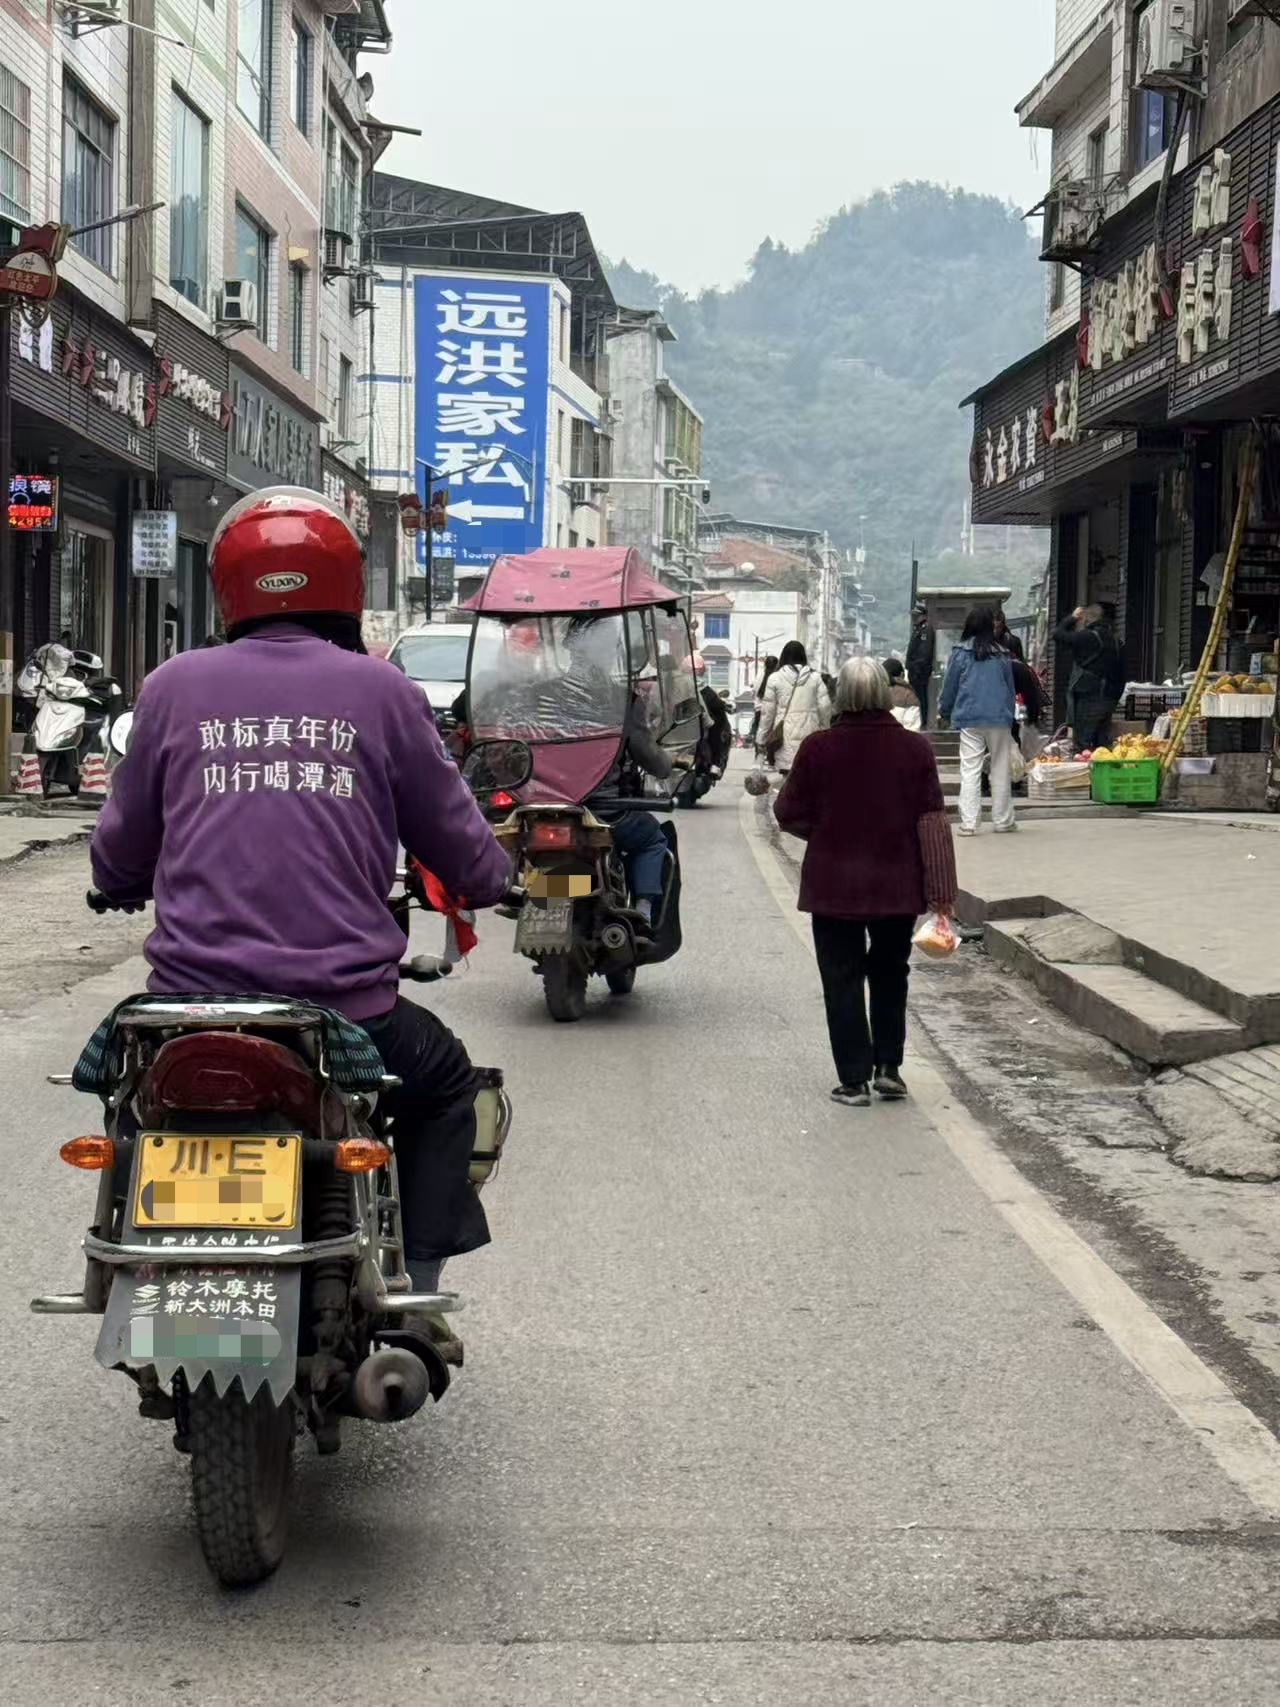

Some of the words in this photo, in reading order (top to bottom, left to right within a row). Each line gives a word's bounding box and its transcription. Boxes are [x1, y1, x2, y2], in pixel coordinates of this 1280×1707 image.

[435, 288, 529, 488] 远洪家私
[199, 715, 356, 752] 敢标真年份
[204, 761, 355, 798] 内行喝潭酒
[164, 1298, 276, 1318] 新大洲本田
[166, 1279, 277, 1301] 铃木摩托
